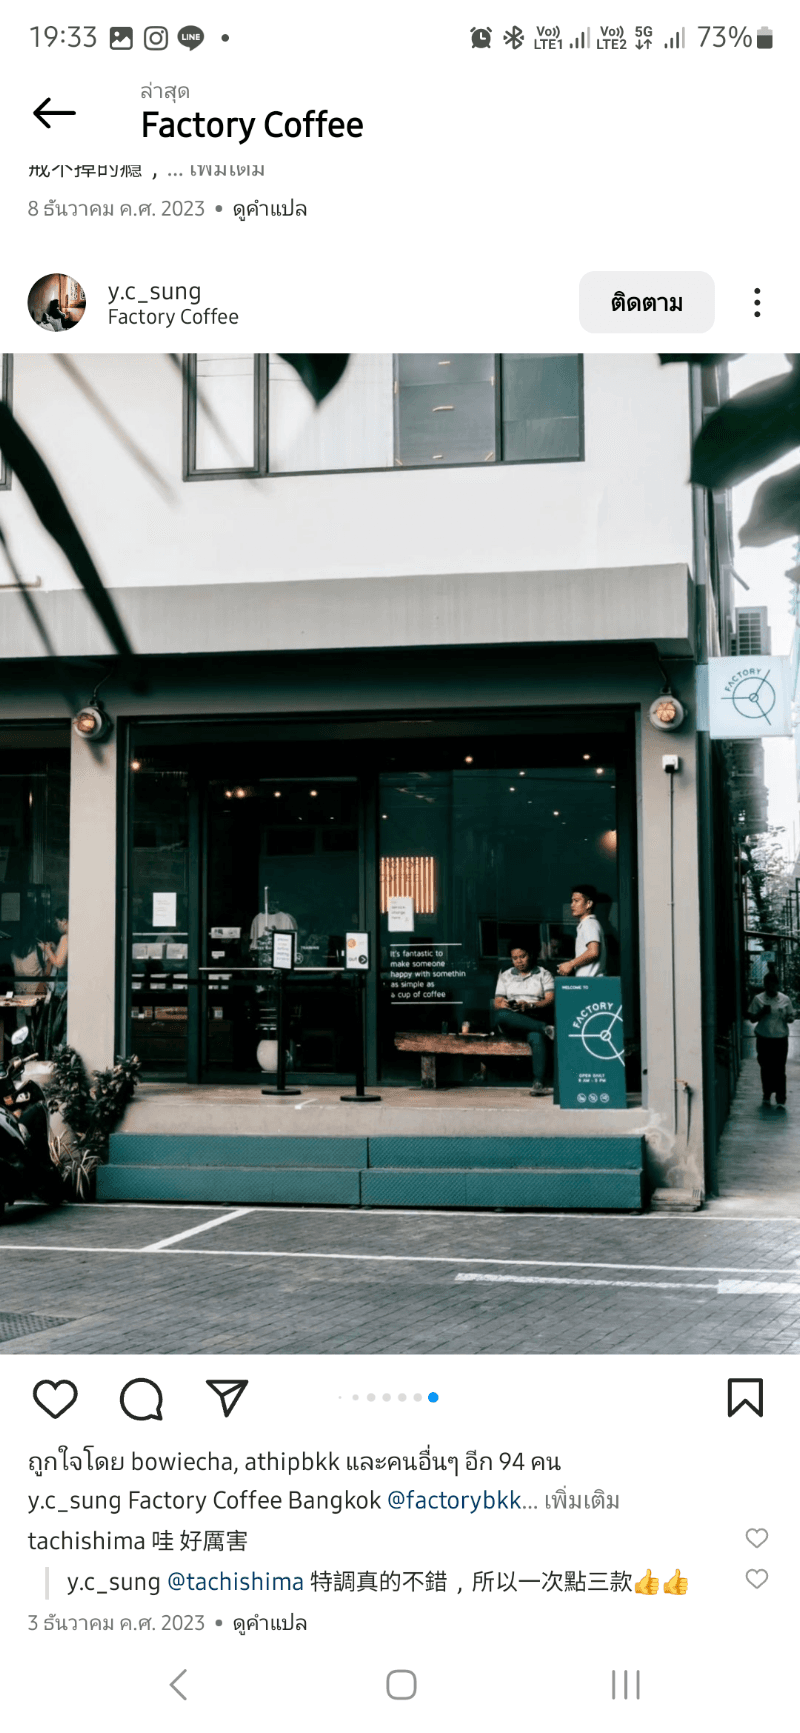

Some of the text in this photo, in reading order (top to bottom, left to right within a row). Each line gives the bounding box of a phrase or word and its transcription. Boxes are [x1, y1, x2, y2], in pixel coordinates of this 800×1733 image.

[30, 26, 97, 47] 19:33
[181, 33, 200, 41] LINE
[635, 26, 652, 37] 5G
[698, 26, 752, 48] 73%
[534, 39, 562, 49] LTE1
[597, 39, 627, 49] LTE2
[141, 82, 190, 103] ล่าสุด
[142, 109, 364, 145] Factory Coffee
[28, 198, 308, 221] 8 ธันวาคม ค.ศ. 2023 ดูคำแปล
[108, 285, 201, 305] y.c_sung
[611, 291, 683, 312] ติดตาม
[109, 308, 239, 328] Factory Coffee
[724, 667, 761, 692] FACTORY
[390, 970, 412, 979] happy
[401, 981, 425, 989] simple
[423, 990, 446, 998] coffee
[572, 1002, 614, 1028] FACTORY
[28, 1444, 562, 1477] ถูกใจโดย bowiecha, athipbkk และคนอื่นๆ อีก 94 คน
[28, 1495, 121, 1514] y.c_sung
[129, 1491, 207, 1514] Factory
[213, 1490, 283, 1509] Coffee
[289, 1490, 382, 1514] Bangkok
[545, 1485, 620, 1509] เพิ่มเติม
[28, 1529, 248, 1551] tachishima 哇 好厲害
[67, 1576, 160, 1595] y.c_sung
[168, 1571, 304, 1591] @tachishima
[28, 1613, 308, 1636] 3 ธันวาคม ค.ศ. 2023 ดูคำแปล
